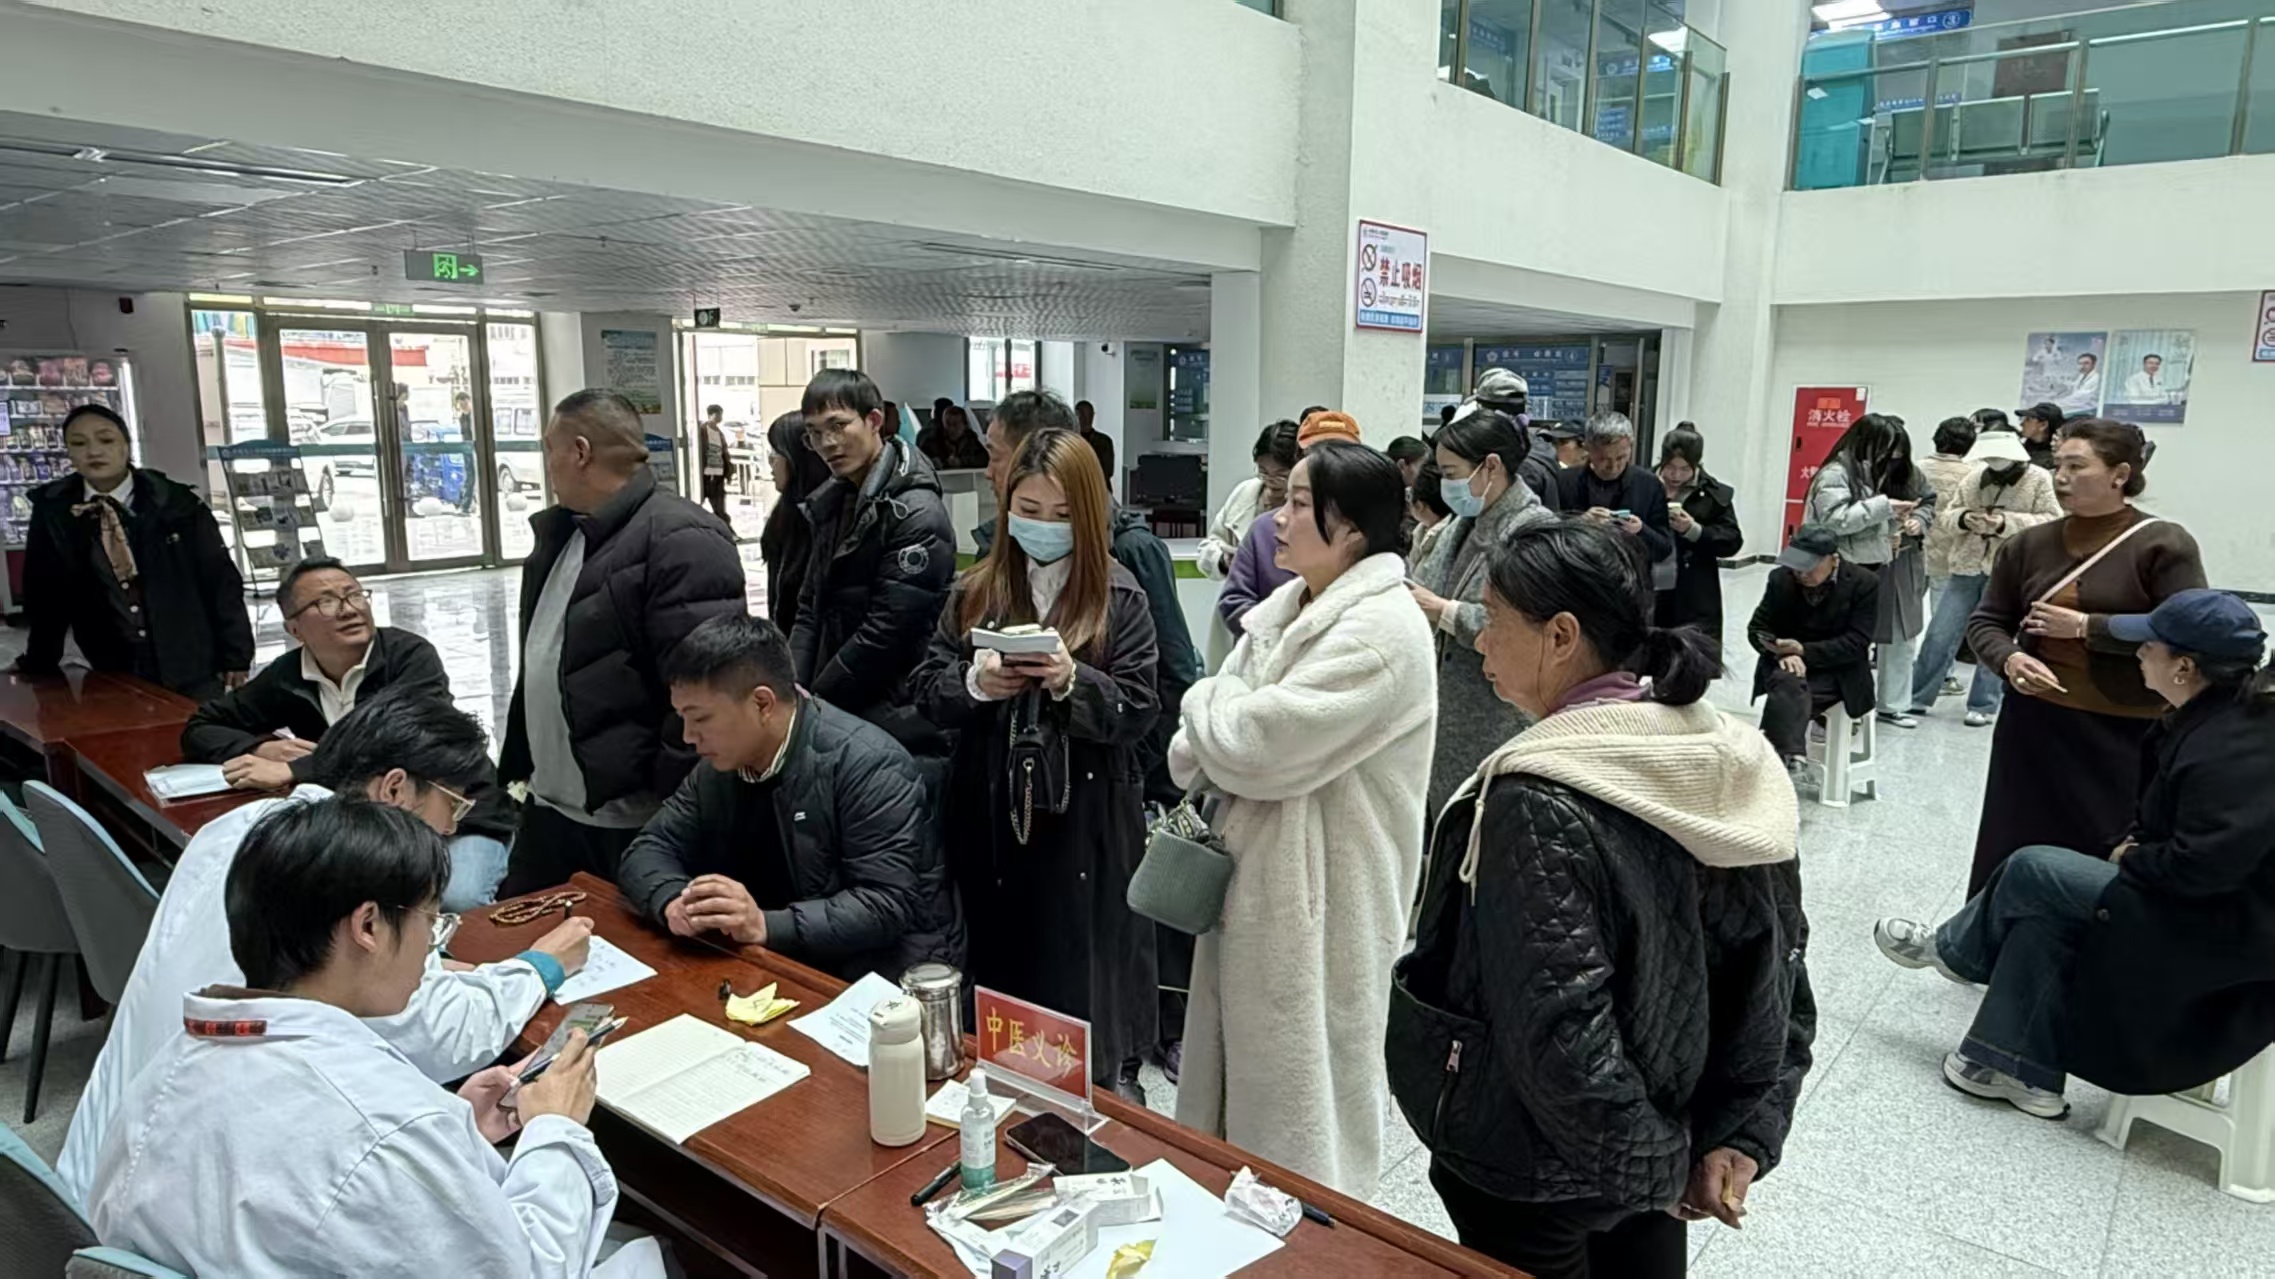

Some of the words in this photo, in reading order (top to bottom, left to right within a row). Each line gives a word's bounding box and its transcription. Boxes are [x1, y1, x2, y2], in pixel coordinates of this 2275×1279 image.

[1379, 255, 1422, 291] 禁止吸烟
[1807, 408, 1851, 423] 消火栓
[985, 1006, 1078, 1079] 中医义诊
